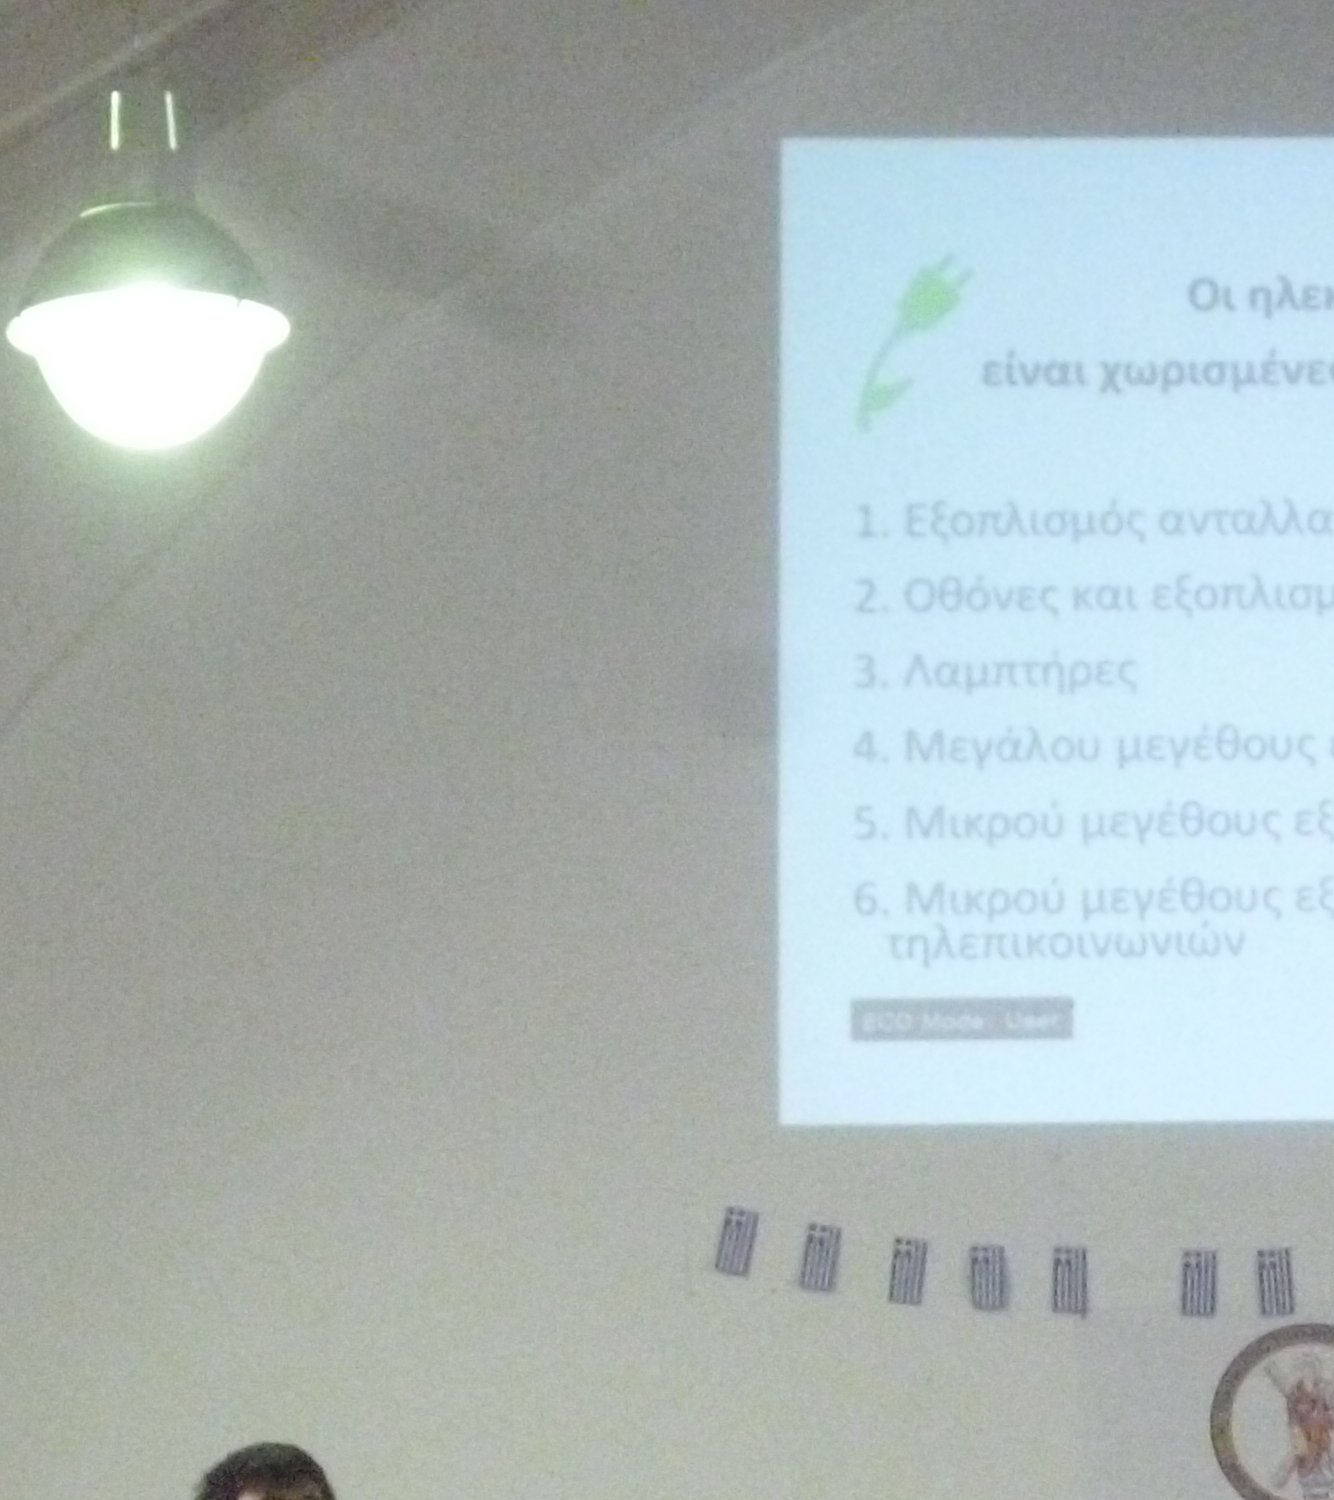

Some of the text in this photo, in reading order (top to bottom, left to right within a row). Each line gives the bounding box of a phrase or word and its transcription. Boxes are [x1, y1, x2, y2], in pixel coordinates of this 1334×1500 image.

[1188, 277, 1235, 311] Οι
[982, 350, 1087, 387] είναι
[858, 504, 887, 539] 1.
[904, 500, 1145, 545] Εξοπλισμός
[855, 578, 887, 614] 2.
[903, 576, 1058, 616] Οθόνες
[1073, 585, 1137, 611] και
[855, 651, 1136, 695] 3. Λαμπτήρες
[854, 730, 887, 762] 4.
[905, 727, 1100, 770] Μεγάλου
[1117, 724, 1316, 769] μεγέθους
[854, 805, 888, 841] 5.
[905, 803, 1063, 846] Μικρού
[1081, 800, 1281, 846] μεγέθους
[854, 882, 888, 916] 6.
[906, 879, 1064, 922] Μικρού
[1082, 877, 1281, 921] μεγέθους
[887, 922, 1245, 968] τηλεπικοινωνιών
